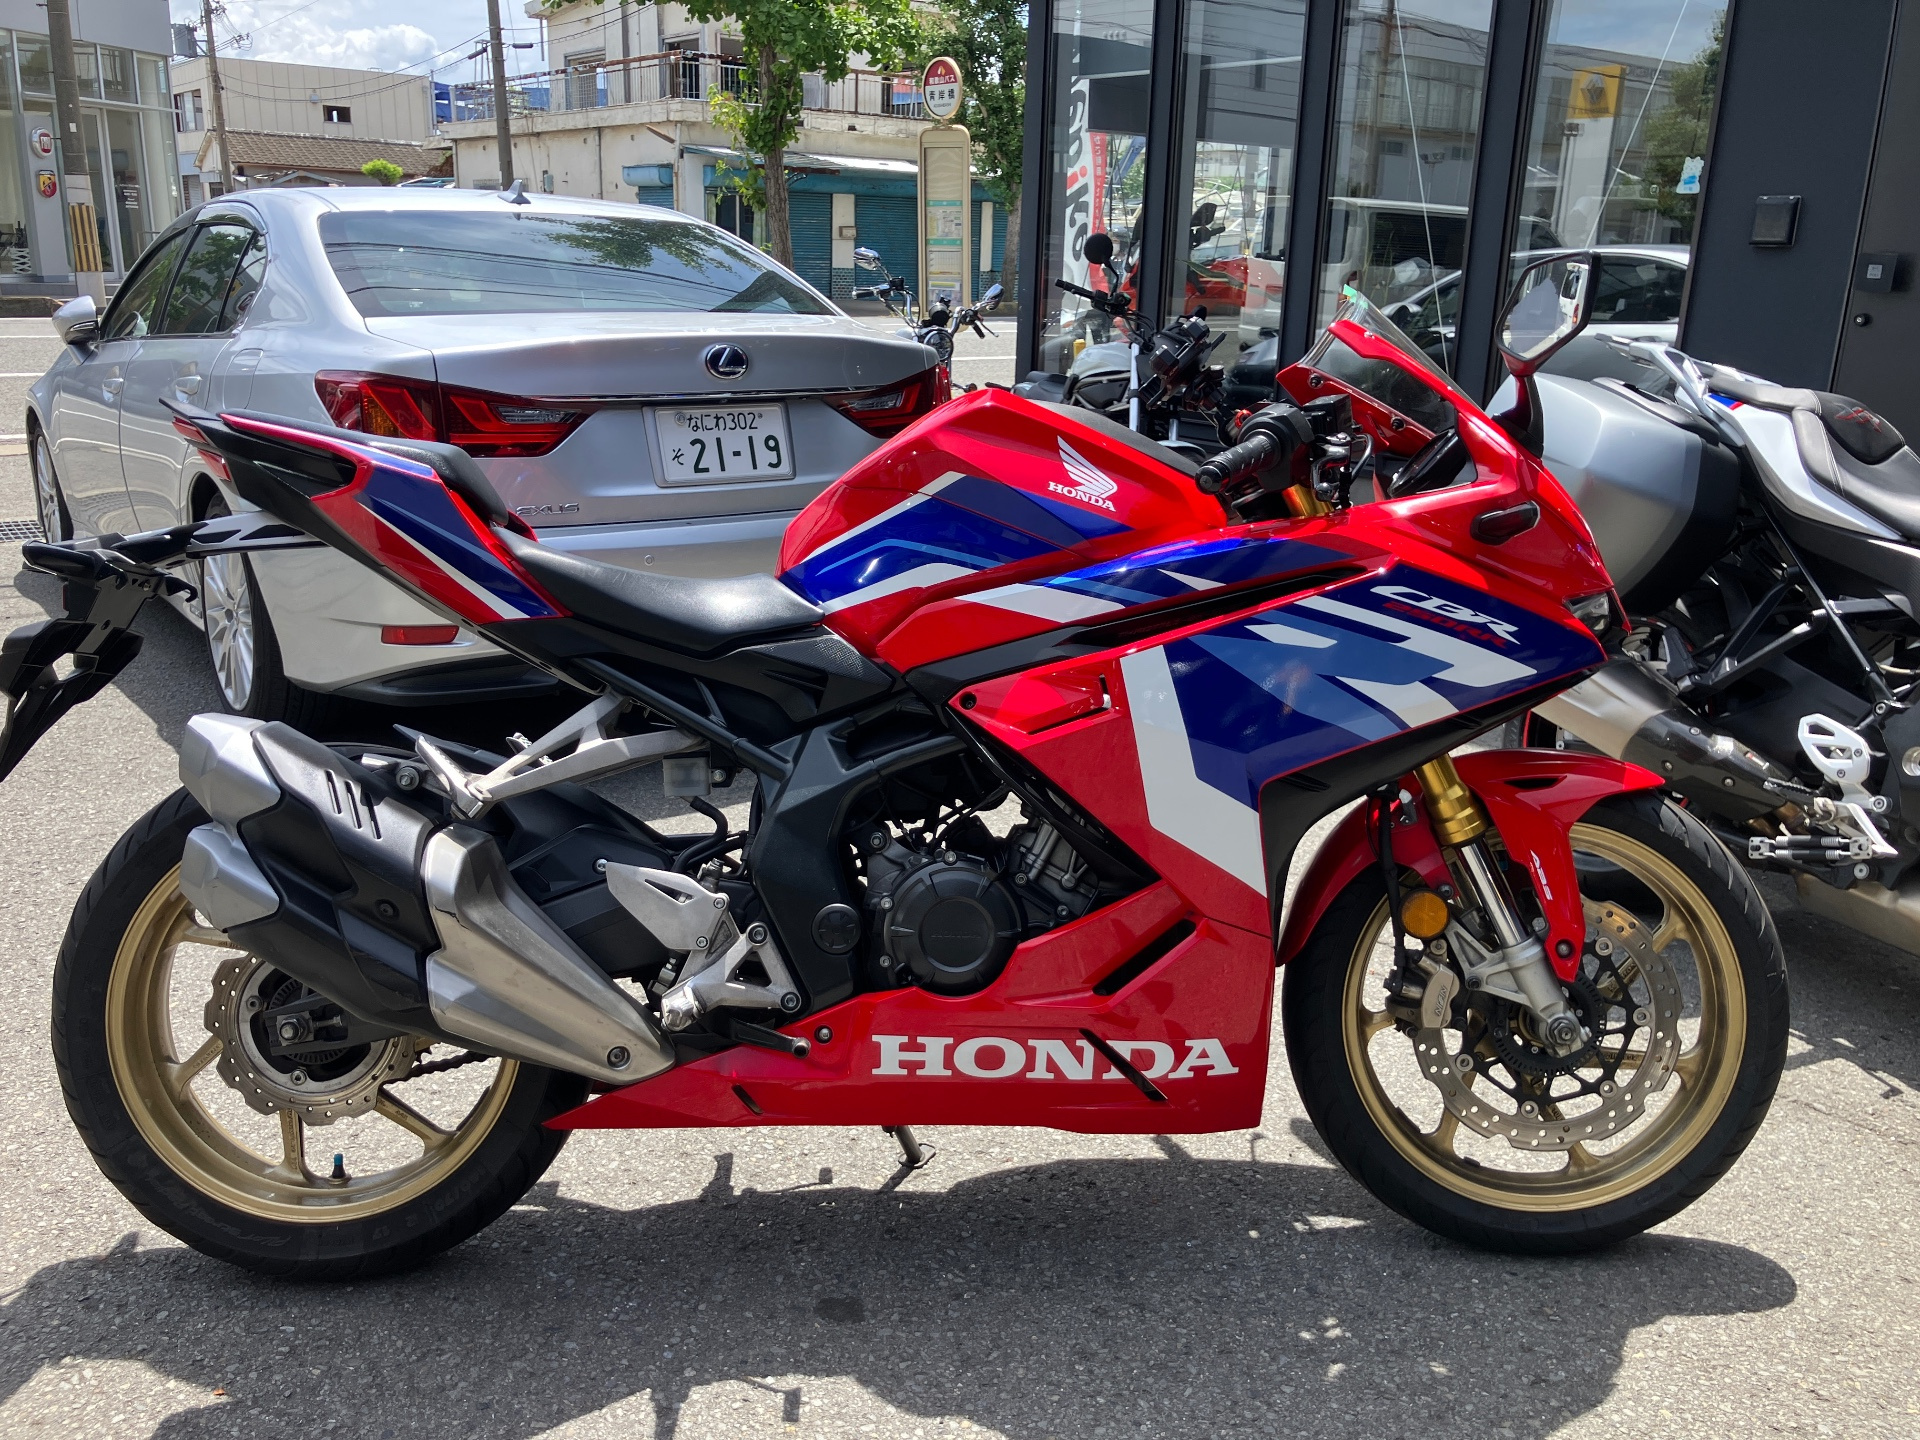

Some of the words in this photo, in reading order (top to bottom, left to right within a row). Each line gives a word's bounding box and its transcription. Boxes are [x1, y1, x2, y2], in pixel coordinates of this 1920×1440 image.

[687, 412, 758, 432] なにわ302
[671, 447, 685, 466] そ
[689, 434, 782, 474] 21-19
[515, 502, 580, 516] EXUS
[1047, 481, 1117, 512] HONDA
[1370, 585, 1521, 645] CBR
[1382, 601, 1508, 649] 250RR
[1530, 849, 1554, 901] ABS
[871, 1034, 1240, 1081] HONDA
